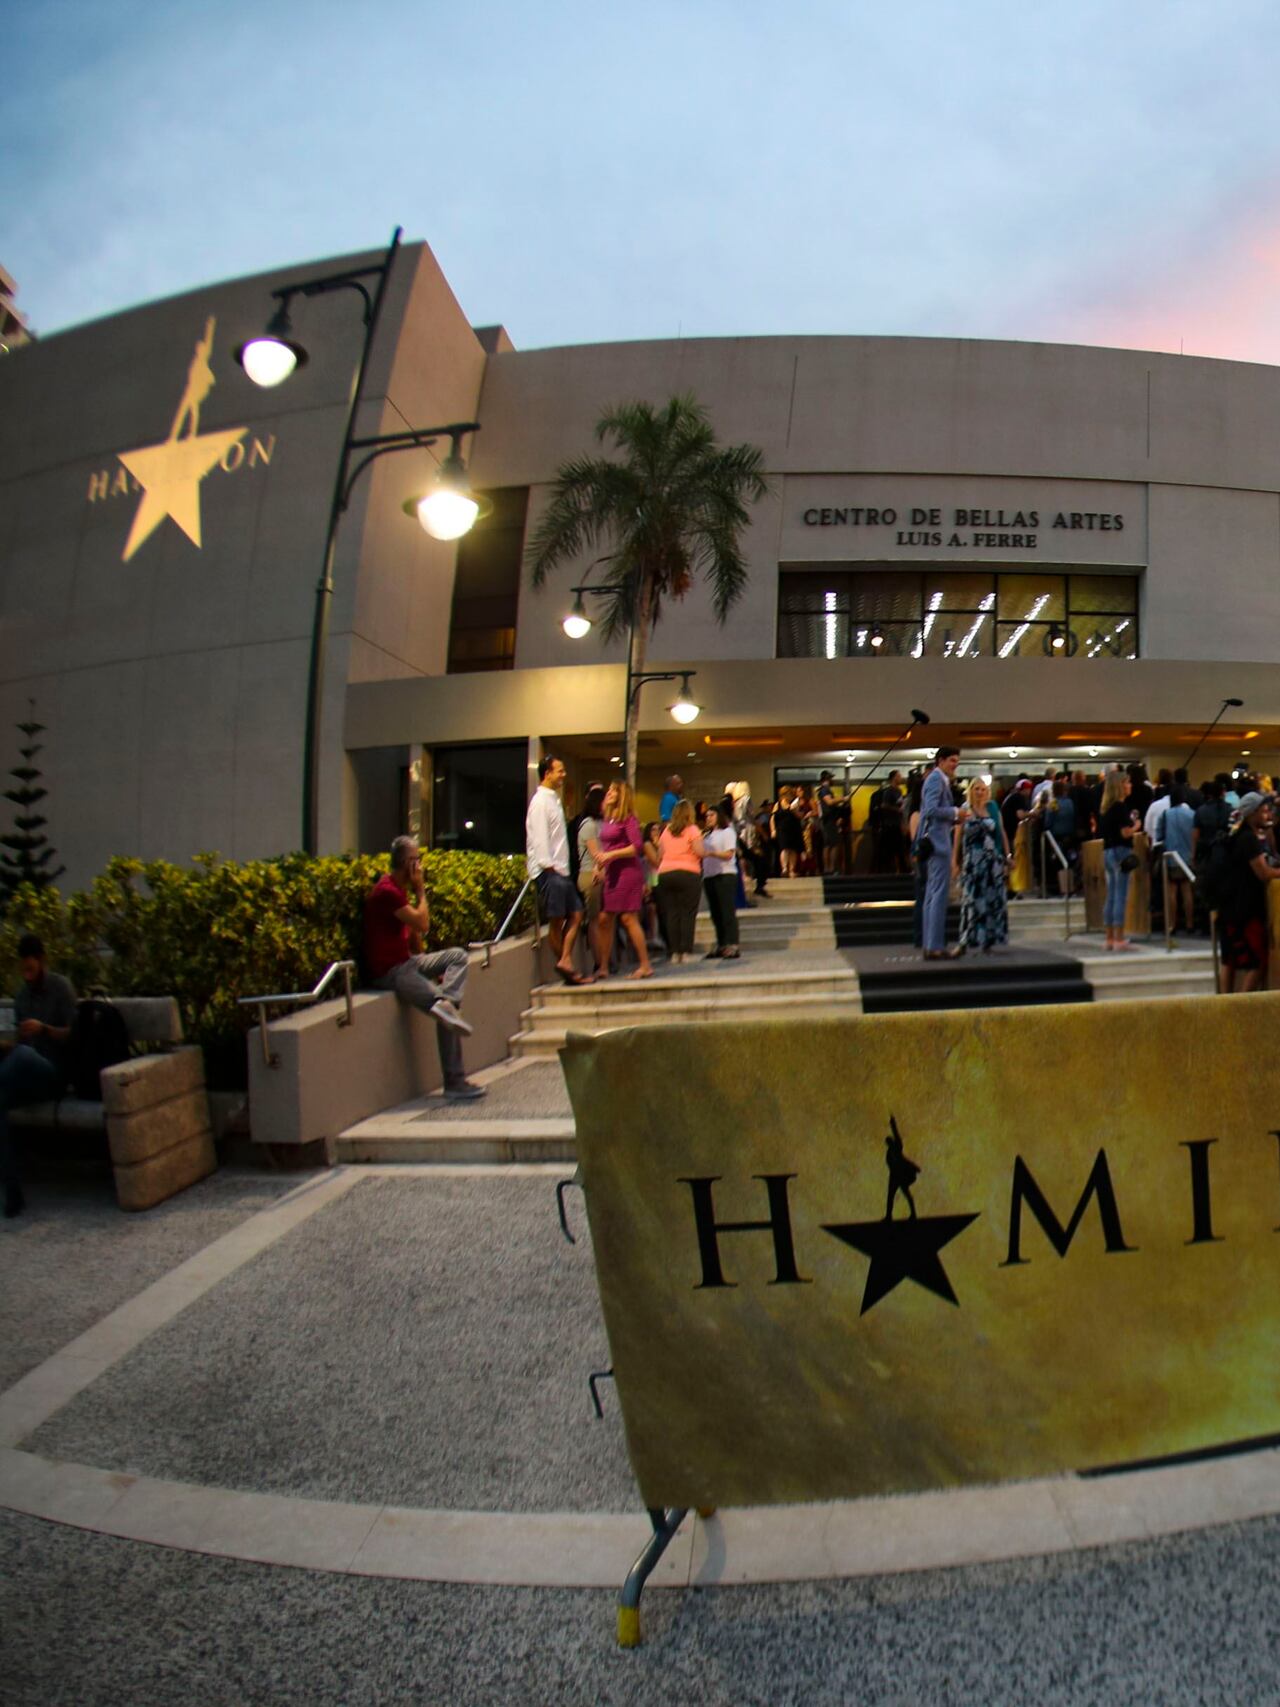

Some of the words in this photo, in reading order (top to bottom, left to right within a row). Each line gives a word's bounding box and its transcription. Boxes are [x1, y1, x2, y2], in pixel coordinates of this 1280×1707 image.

[88, 435, 275, 502] HAON
[803, 508, 897, 526] CENTRO
[911, 508, 941, 526] DE
[955, 510, 1040, 528] BELLAS
[1052, 512, 1124, 531] ARTES
[896, 532, 942, 546] LUIS
[947, 533, 968, 547] A.
[973, 533, 1037, 549] FERRE
